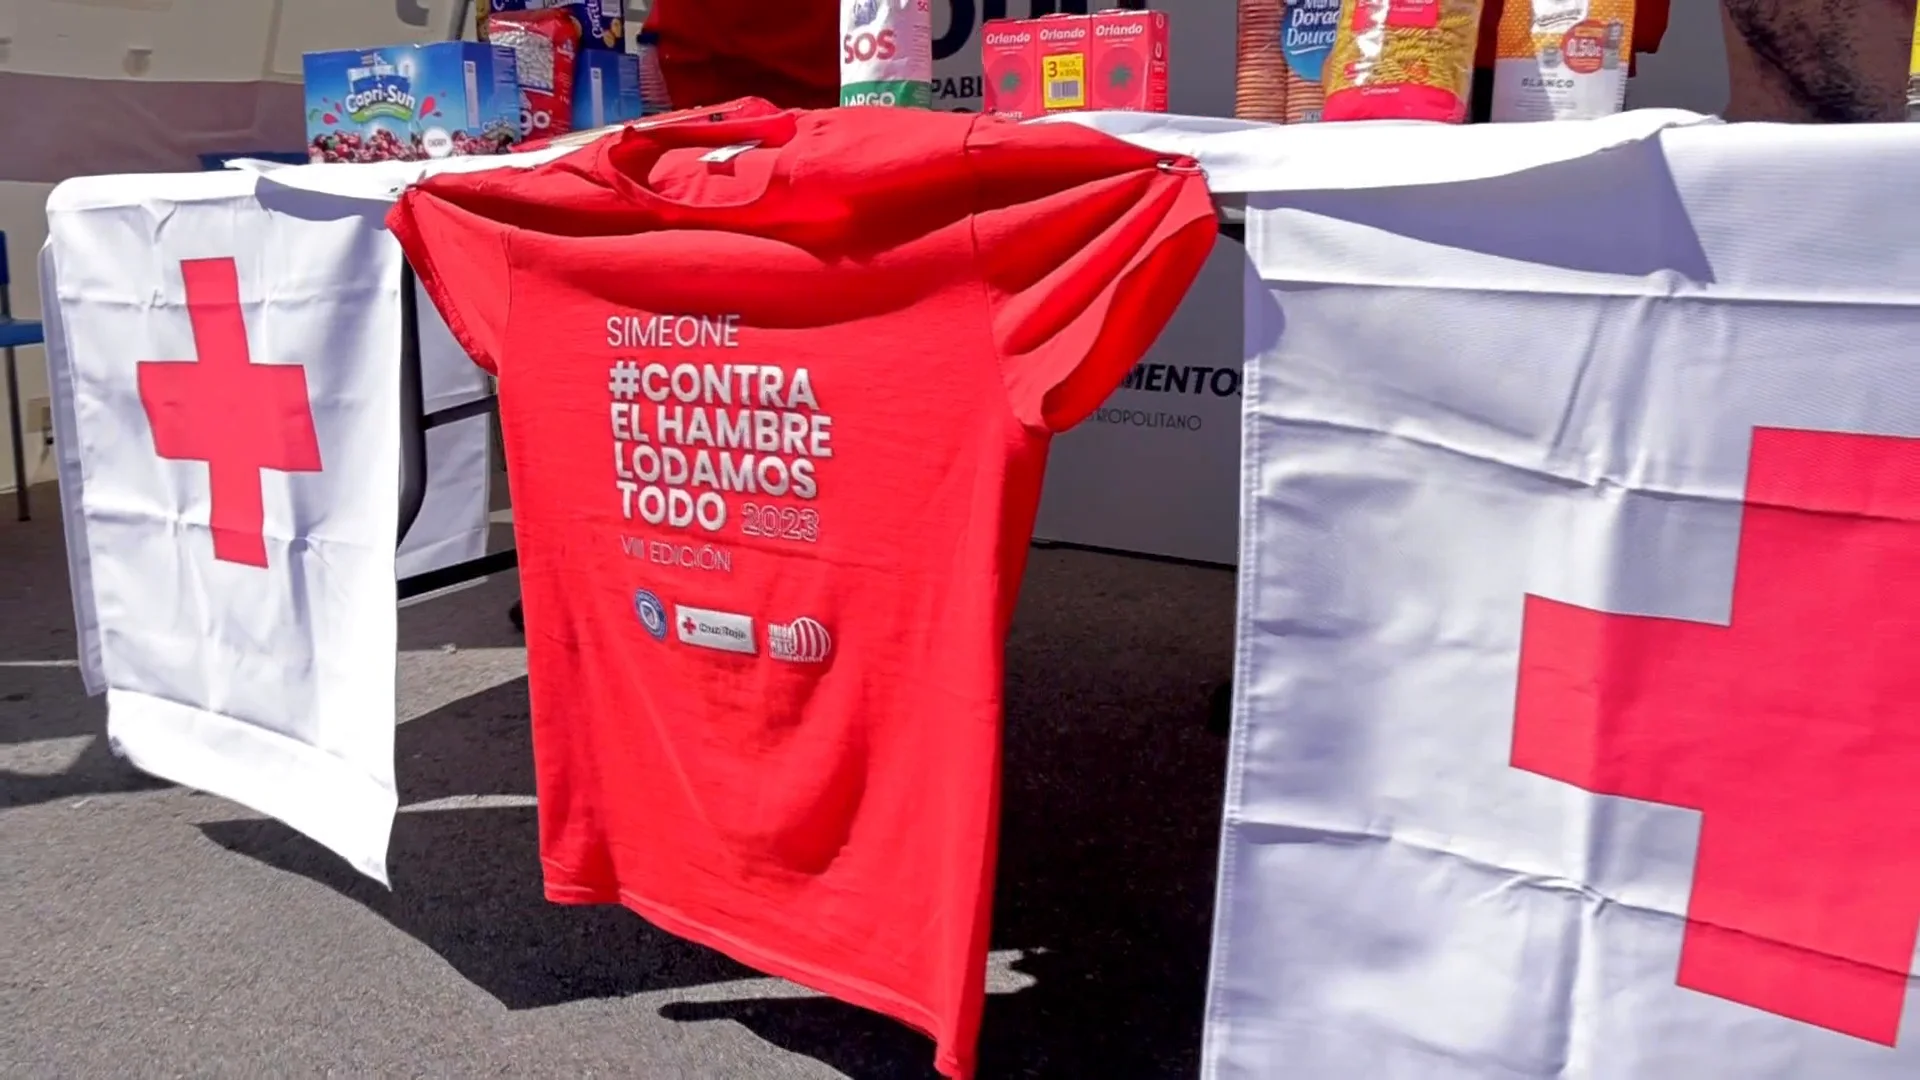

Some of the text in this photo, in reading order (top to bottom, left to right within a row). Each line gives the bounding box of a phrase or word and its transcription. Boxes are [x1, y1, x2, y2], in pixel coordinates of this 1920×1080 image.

[986, 32, 1031, 45] Orlando
[1040, 28, 1085, 40] Orlando
[1095, 23, 1143, 36] Orlando
[844, 29, 896, 64] SOS
[1048, 61, 1058, 79] 3
[1522, 77, 1575, 88] BLANCO
[345, 83, 416, 113] Capri-Sun
[607, 314, 740, 347] SIMEONE
[608, 360, 820, 410] #CONTRA
[610, 402, 833, 457] EL HAMBRE
[614, 442, 817, 499] LODAMOS
[616, 480, 820, 542] TODO 2023
[651, 541, 732, 572] EDICIÓN
